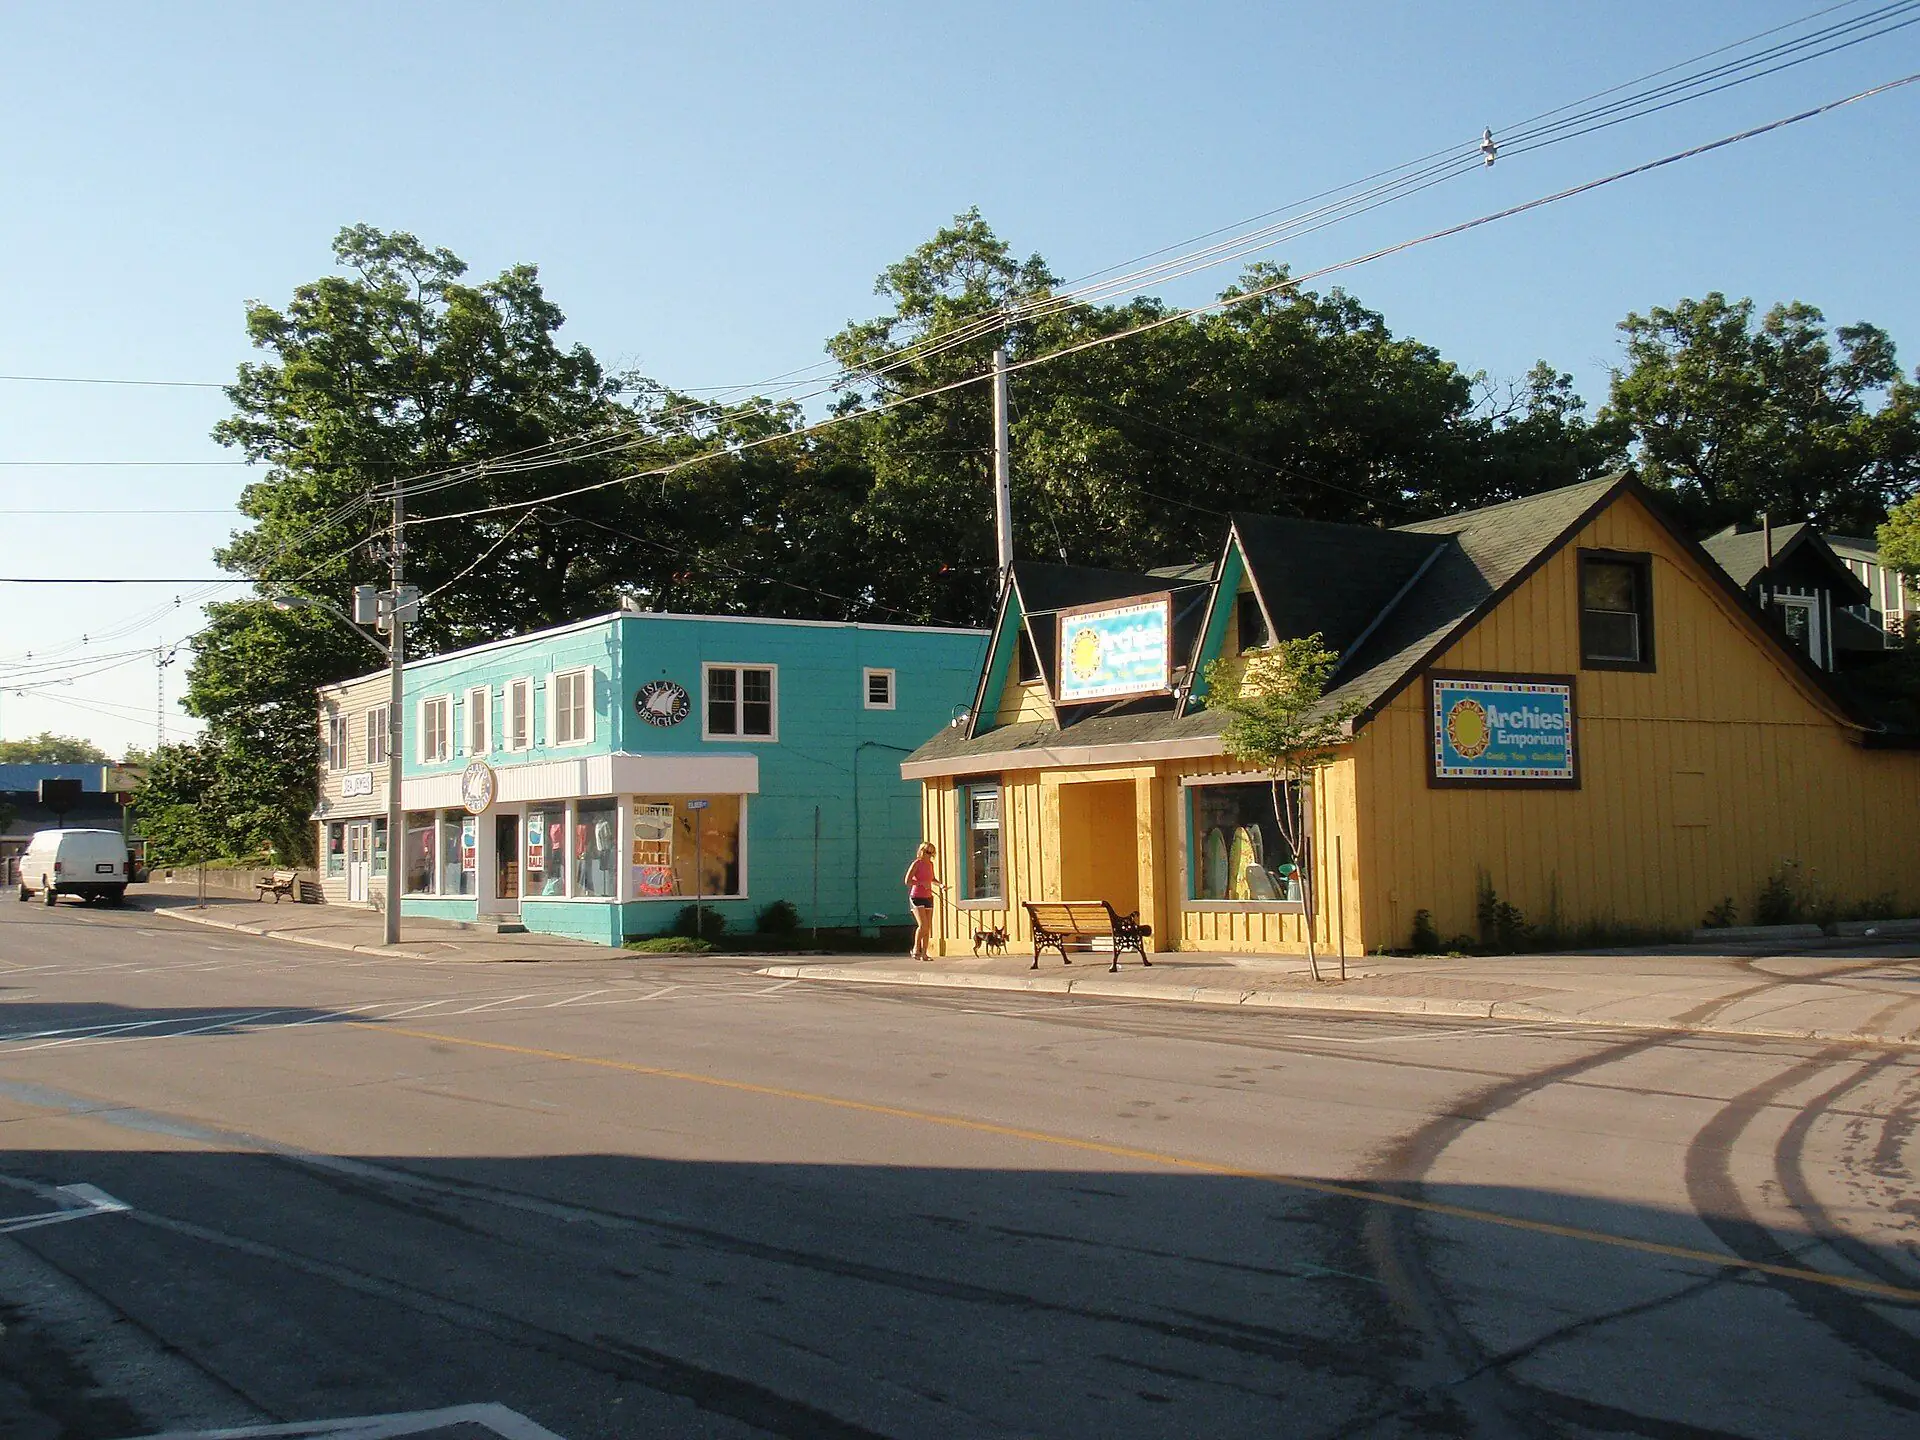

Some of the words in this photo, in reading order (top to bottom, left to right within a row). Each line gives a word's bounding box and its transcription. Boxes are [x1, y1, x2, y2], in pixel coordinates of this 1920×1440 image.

[642, 682, 685, 698] ISLAND
[639, 707, 672, 727] BEACH
[1486, 704, 1564, 730] Archies
[1497, 729, 1564, 749] Emporium
[634, 805, 660, 817] HURRY
